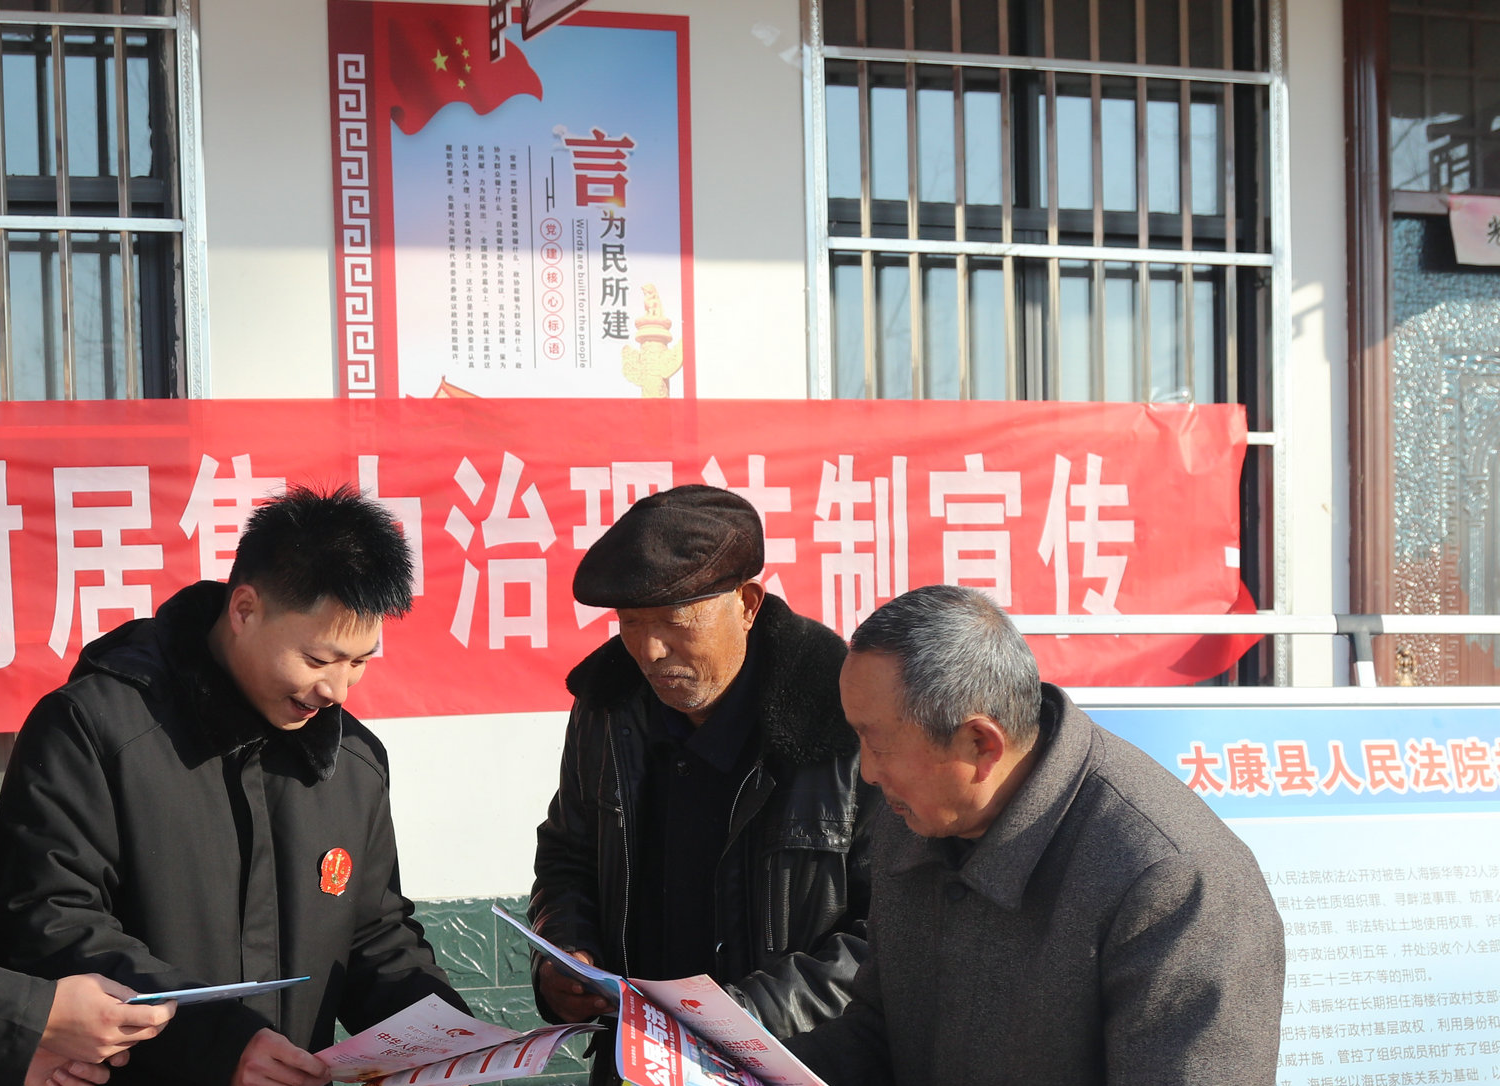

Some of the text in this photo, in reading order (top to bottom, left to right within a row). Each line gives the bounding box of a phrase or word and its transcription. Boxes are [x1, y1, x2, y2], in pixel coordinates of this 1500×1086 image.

[564, 128, 636, 340] 言 为民所建
[575, 219, 585, 252] Words
[543, 221, 562, 357] 党建核心标语
[577, 272, 586, 297] built
[578, 298, 587, 312] for
[578, 314, 587, 332] the
[577, 334, 587, 368] people
[1179, 739, 1500, 795] 太康县人民法院
[1283, 989, 1500, 1016] 告人海振华在长期担任海楼行政村支部
